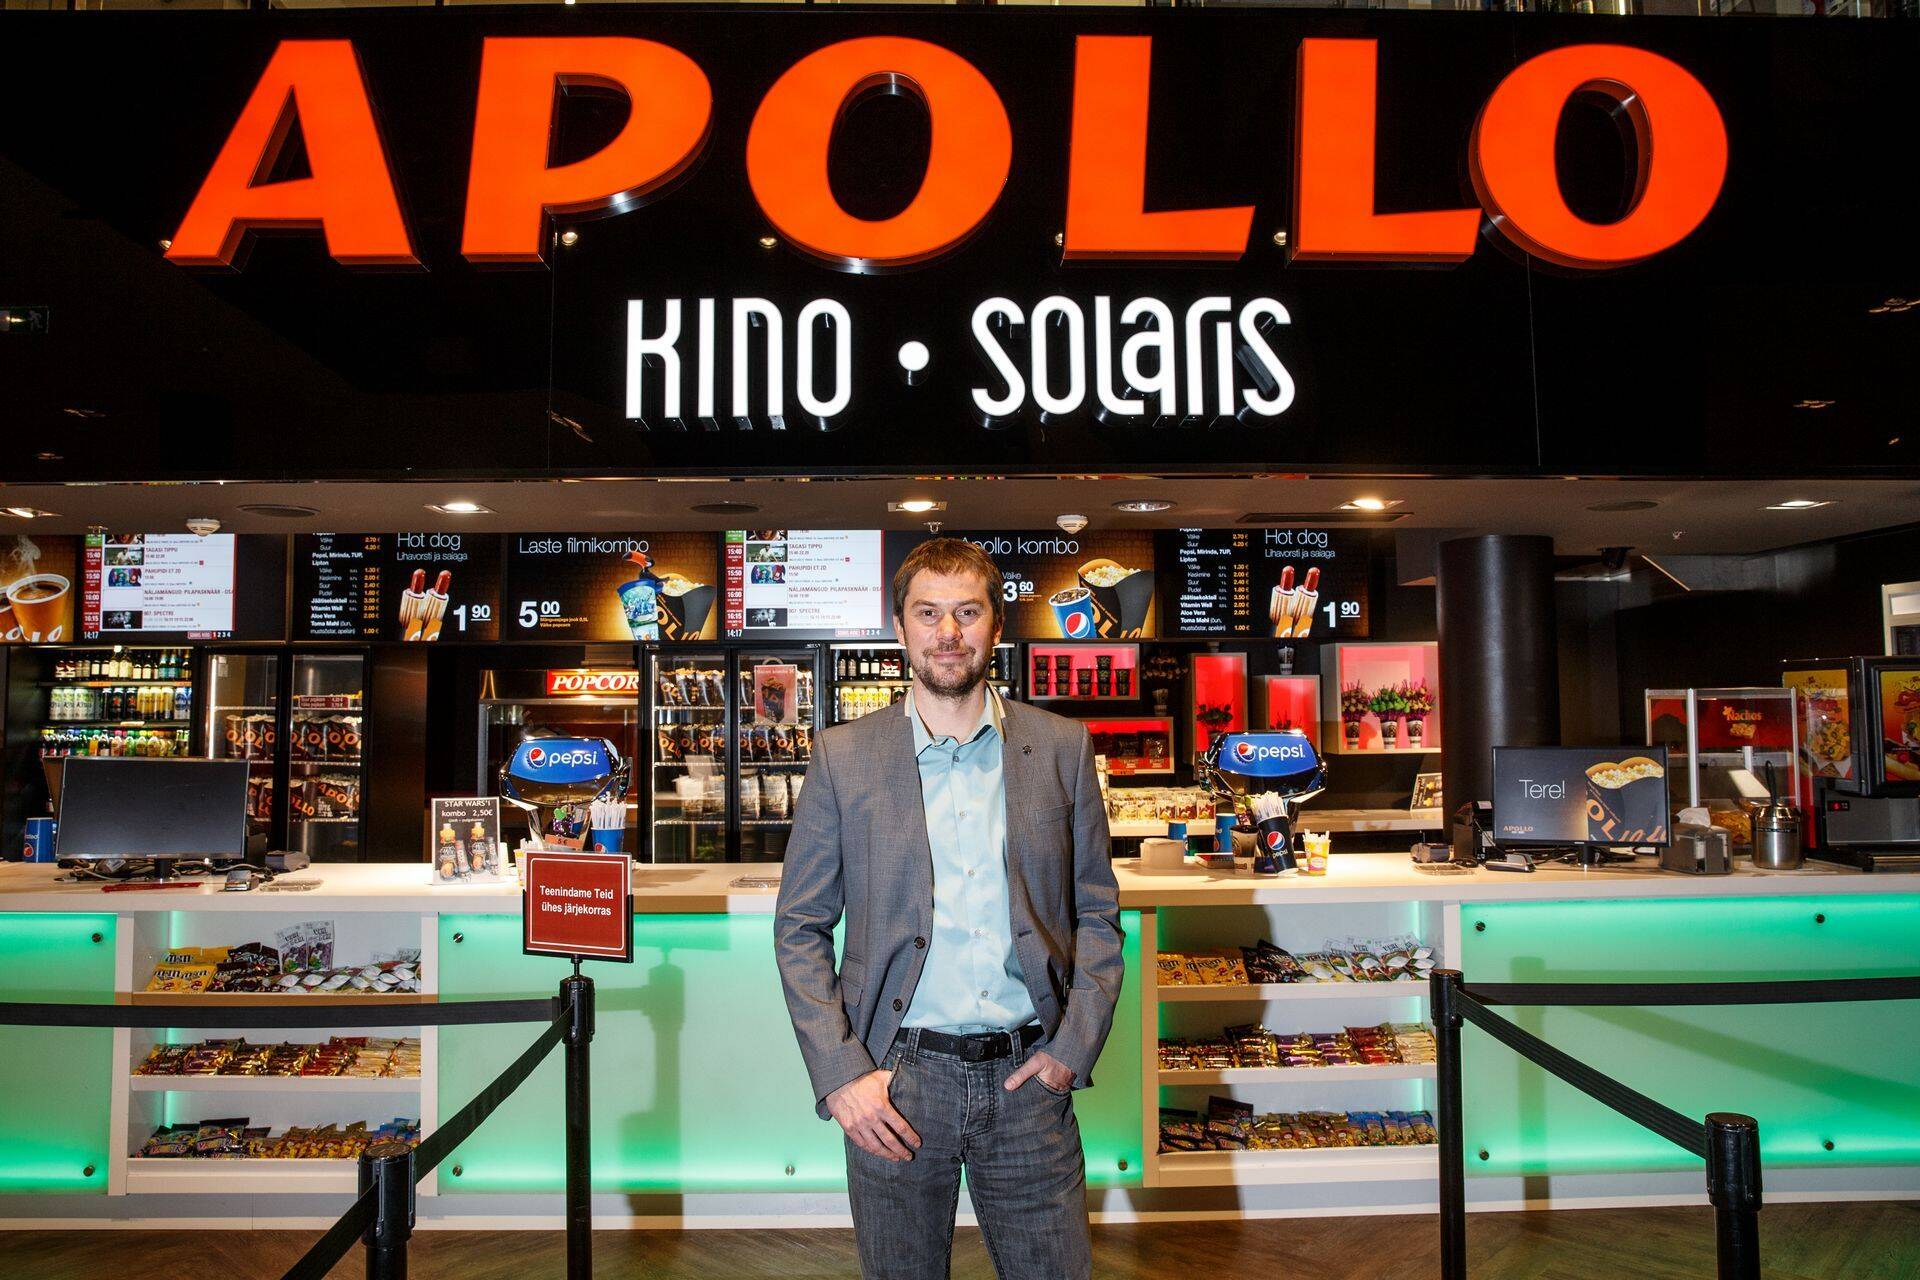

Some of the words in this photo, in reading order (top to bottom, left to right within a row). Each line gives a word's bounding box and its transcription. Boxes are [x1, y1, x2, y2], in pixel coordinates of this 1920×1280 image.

[166, 37, 1728, 264] APOLLO
[397, 533, 424, 548] Hot
[430, 533, 460, 550] dog
[519, 538, 562, 554] Laste
[567, 537, 649, 553] filmikombo
[1018, 537, 1078, 554] kombo
[1265, 529, 1292, 544] Hot
[1297, 529, 1328, 548] dog
[397, 552, 432, 561] Lihavorsti
[434, 552, 441, 562] ja
[443, 553, 468, 562] saiaga
[1265, 549, 1301, 558] Lihavorsti
[1302, 549, 1308, 559] ja
[1310, 550, 1336, 558] saiaga
[1002, 572, 1021, 580] Väike
[1003, 581, 1018, 602] 3
[1020, 582, 1034, 592] 60
[453, 605, 466, 631] 1
[472, 605, 491, 619] 90
[518, 601, 538, 628] 5
[541, 601, 560, 614] 00
[1323, 602, 1336, 628] 1
[1341, 602, 1360, 615] 90
[549, 751, 598, 768] pepsi
[1258, 744, 1303, 761] pepsi
[1518, 779, 1566, 799] Tere!
[472, 809, 493, 817] 2,50€
[1272, 849, 1288, 859] pepsi
[540, 885, 592, 899] Teenindame
[594, 888, 614, 900] Teid
[542, 902, 562, 913] ühes
[564, 903, 612, 916] järjekorras
